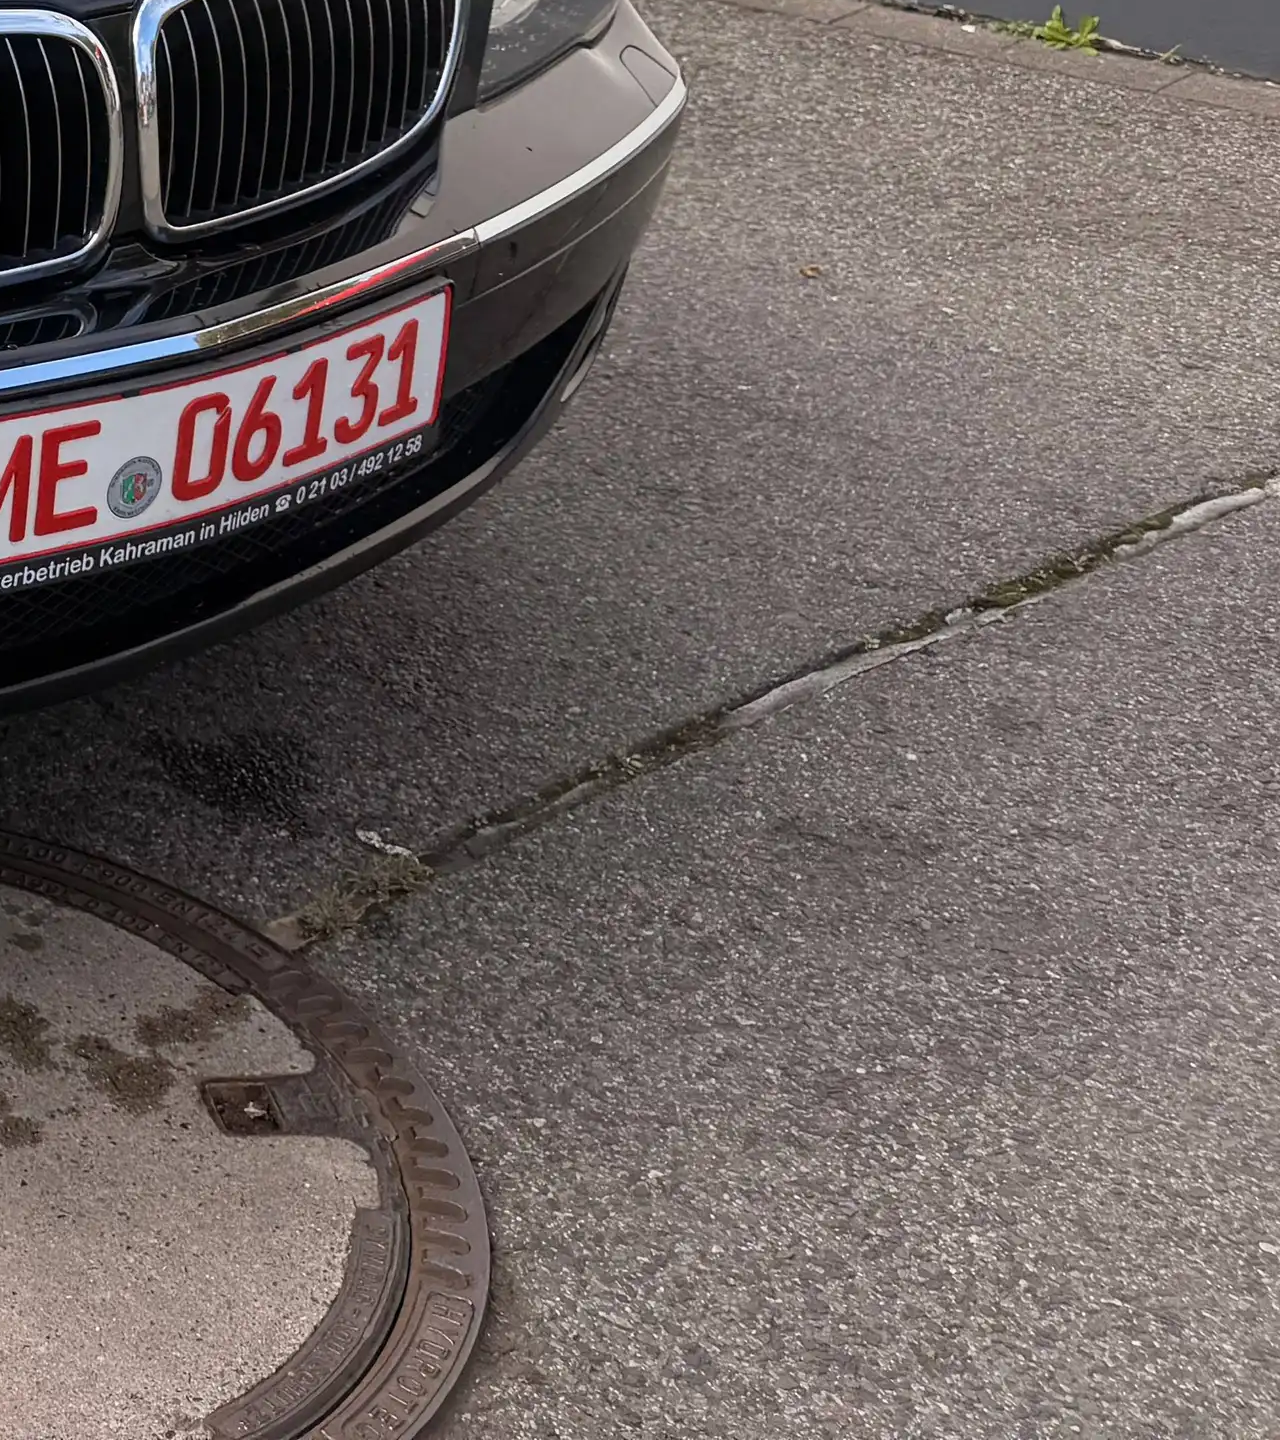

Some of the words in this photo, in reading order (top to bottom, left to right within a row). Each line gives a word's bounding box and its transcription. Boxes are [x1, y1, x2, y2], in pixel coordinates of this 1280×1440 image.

[170, 318, 420, 502] 06131
[98, 528, 196, 569] Kahraman
[199, 522, 216, 541] in
[219, 502, 270, 534] Hilden
[356, 1301, 467, 1439] HYDROTEC
